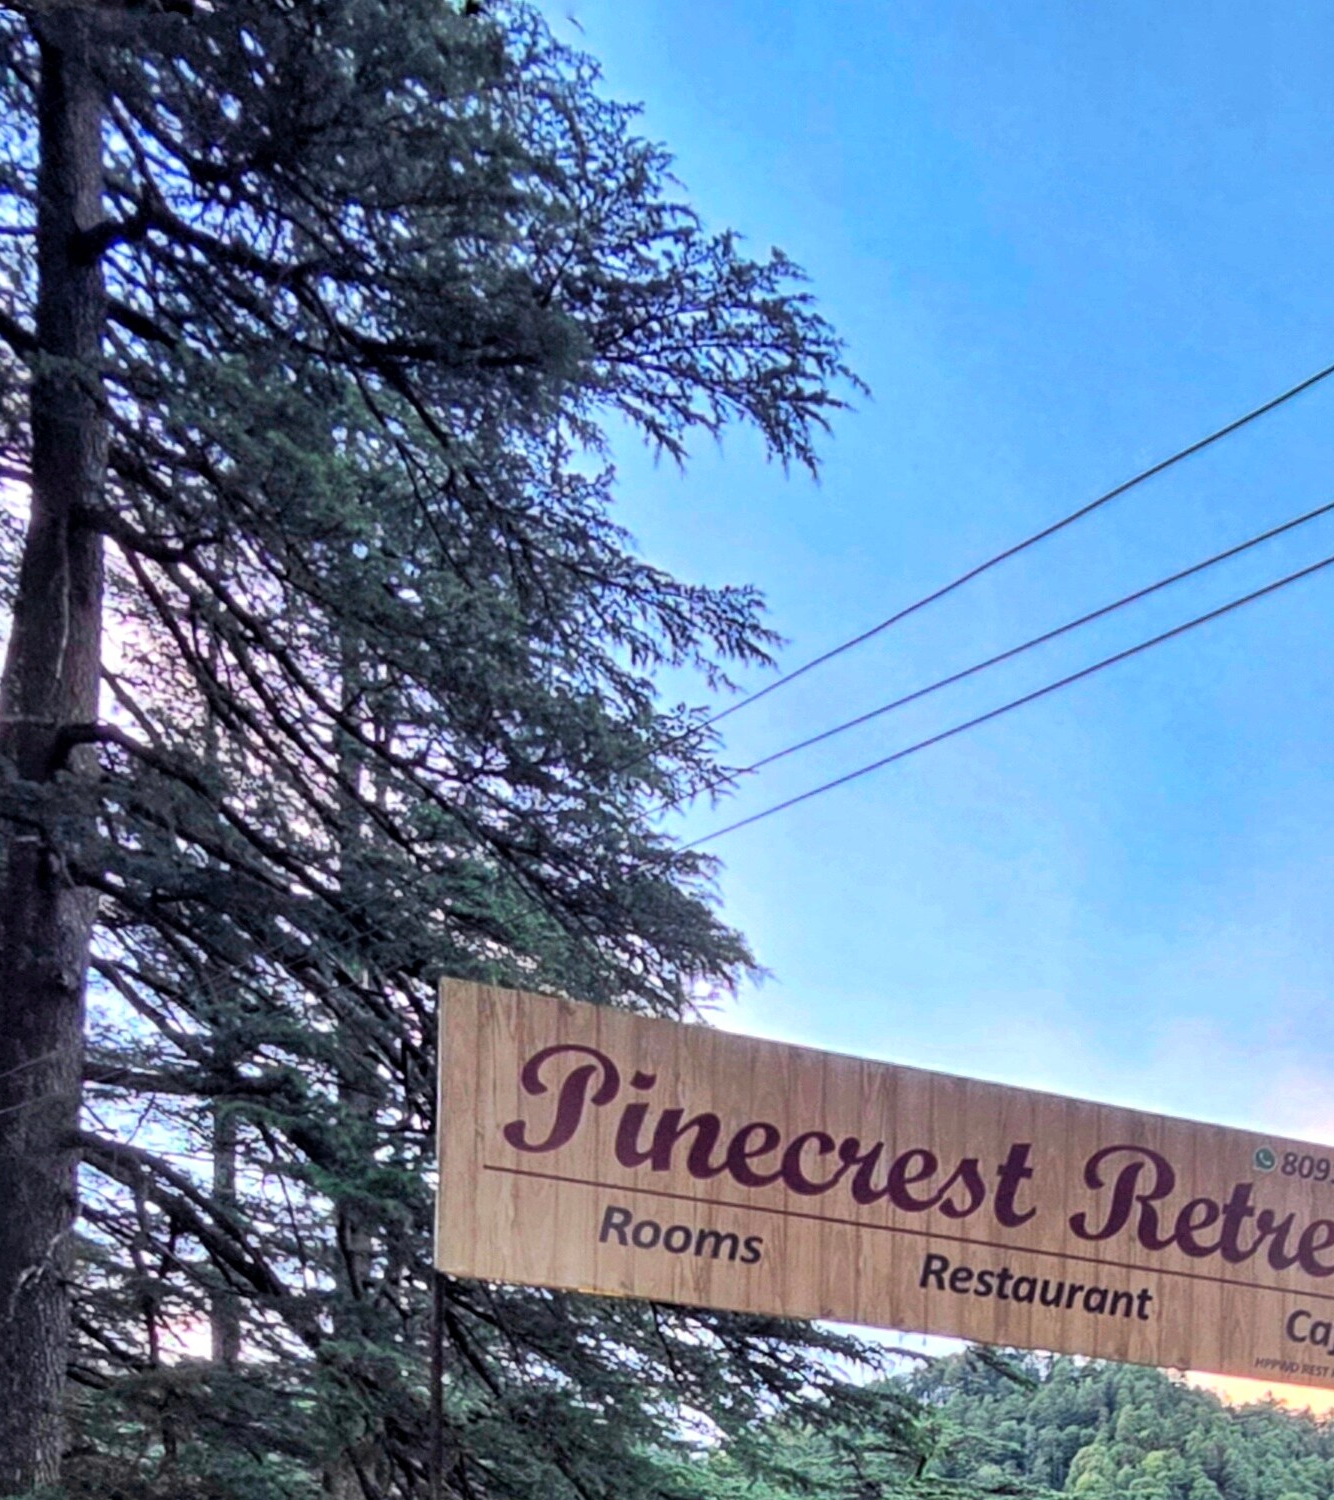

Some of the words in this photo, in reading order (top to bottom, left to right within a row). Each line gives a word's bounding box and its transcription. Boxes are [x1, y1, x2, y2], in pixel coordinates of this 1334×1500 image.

[503, 1043, 1038, 1228] Pinecrest
[599, 1205, 763, 1264] Rooms
[919, 1252, 1154, 1321] Restaurant
[1301, 1364, 1330, 1378] REST
